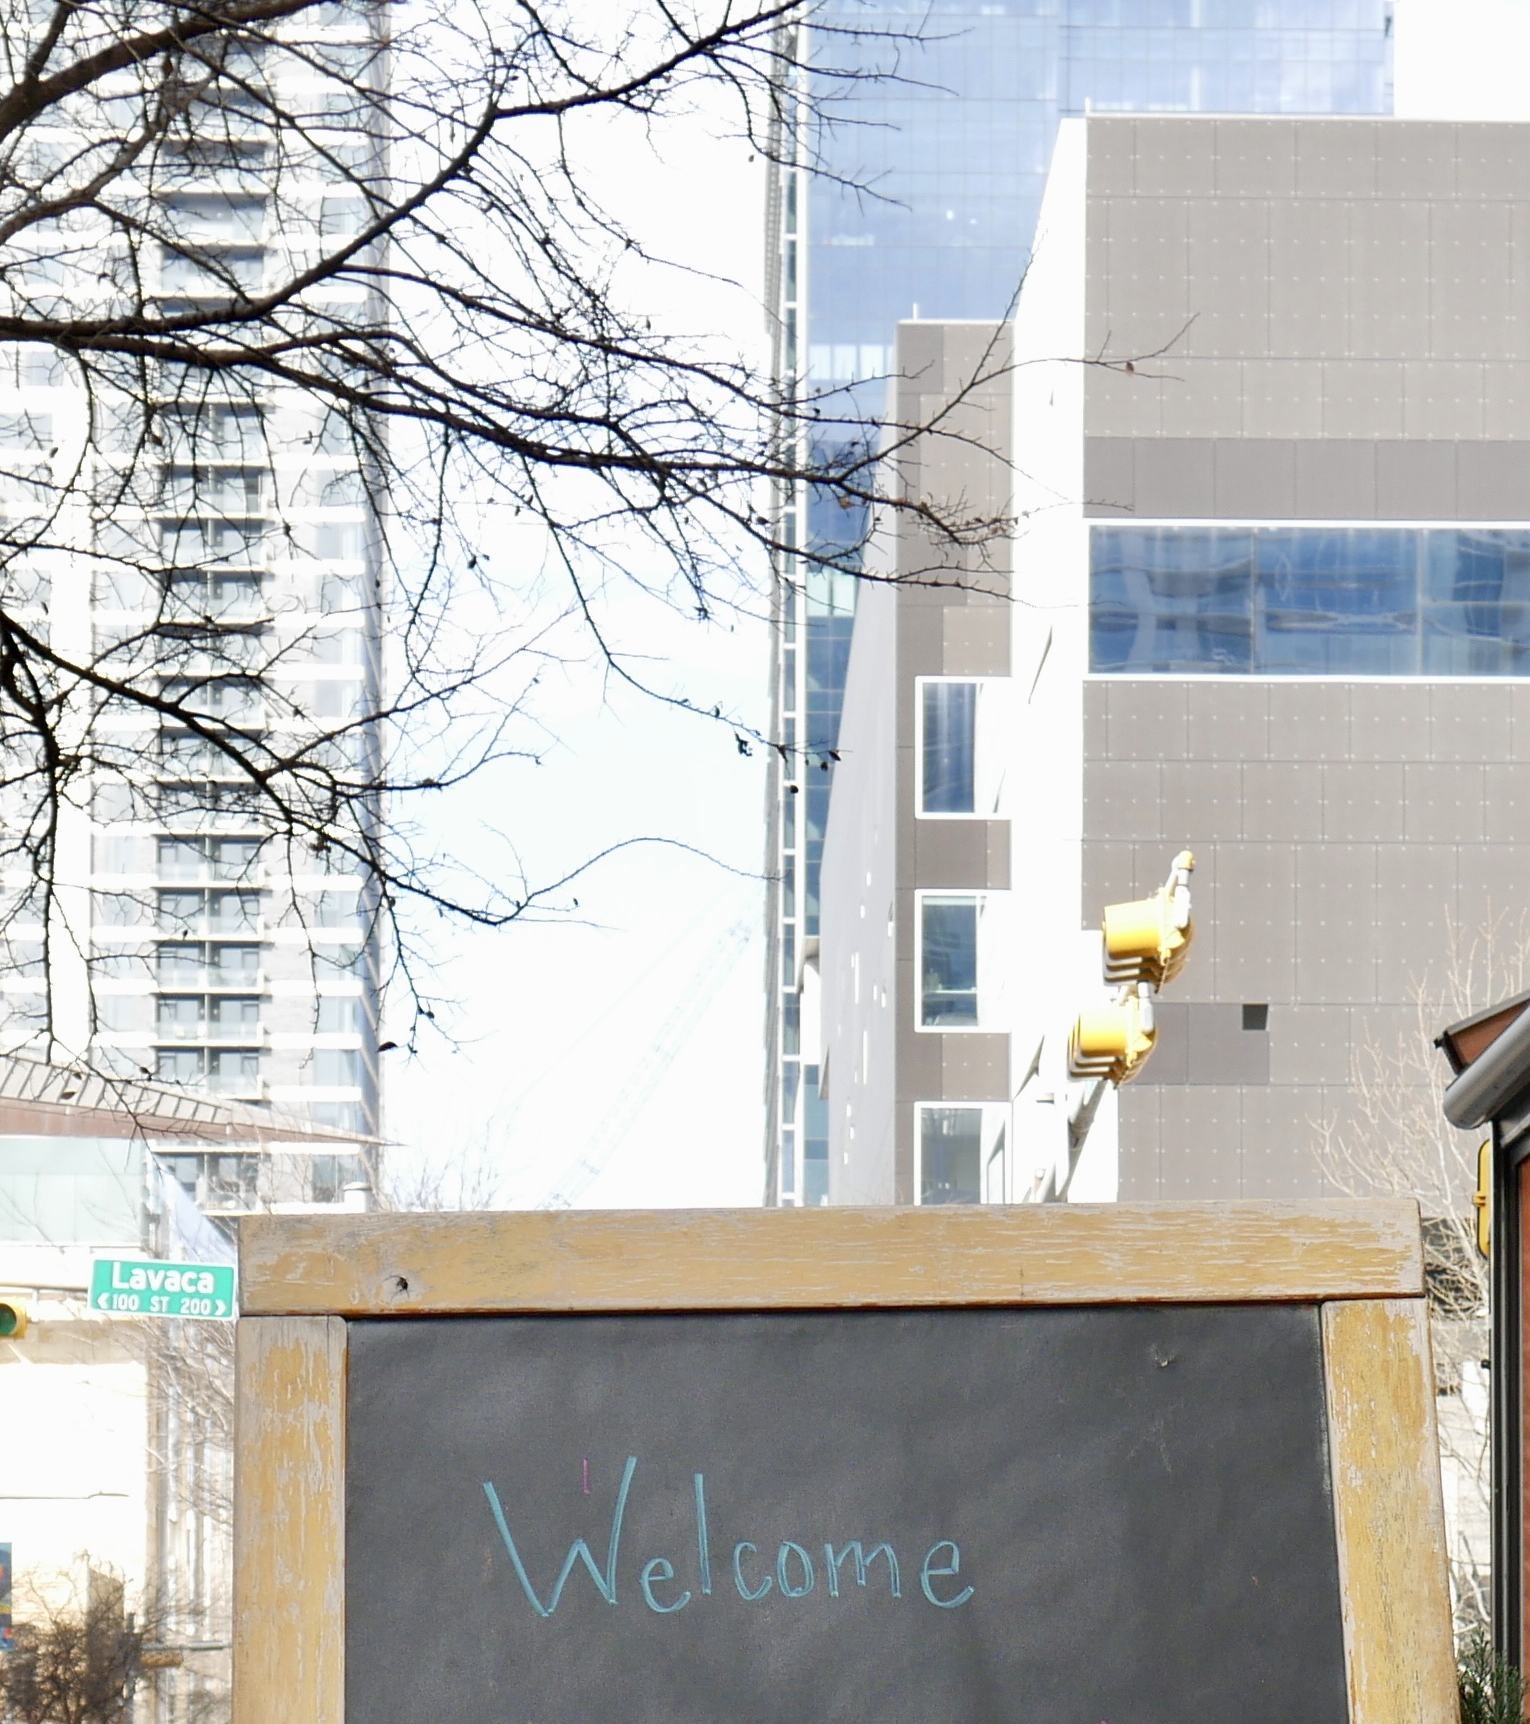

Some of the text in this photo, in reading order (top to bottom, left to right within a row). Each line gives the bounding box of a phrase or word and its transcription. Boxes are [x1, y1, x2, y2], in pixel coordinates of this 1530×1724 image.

[111, 1261, 215, 1294] Lavaca
[112, 1293, 211, 1316] 100 ST 200
[482, 1456, 975, 1617] Welcome
